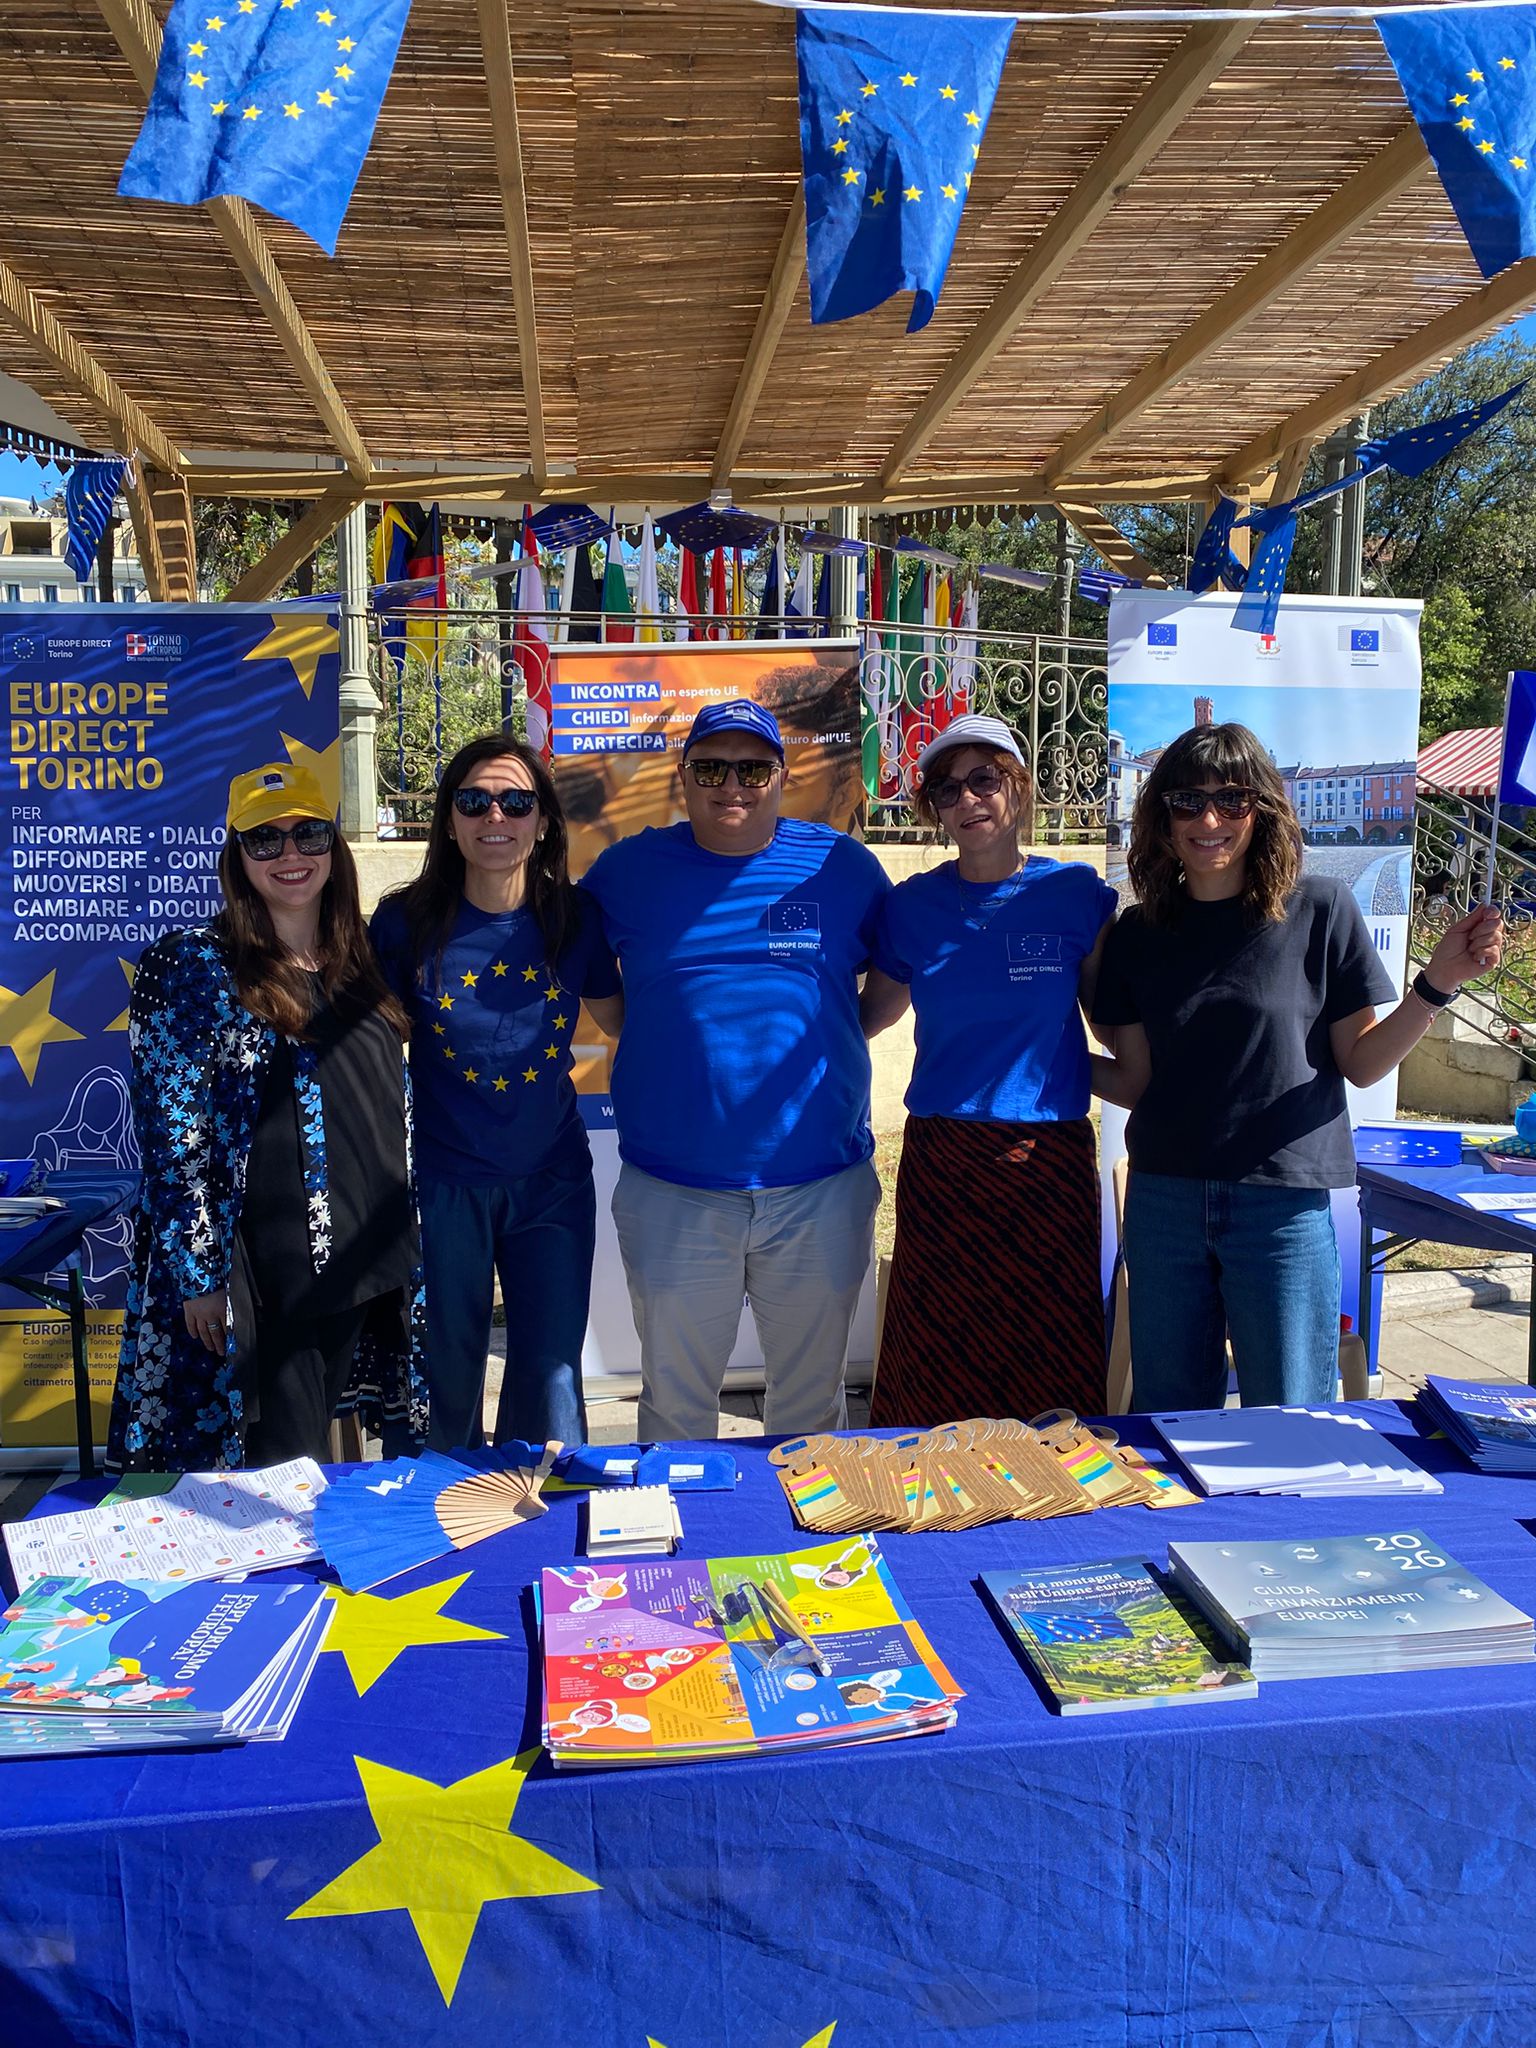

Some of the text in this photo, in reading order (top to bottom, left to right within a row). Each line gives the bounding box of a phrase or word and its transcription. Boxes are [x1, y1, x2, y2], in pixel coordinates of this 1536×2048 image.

[48, 639, 112, 648] EUROPE DIRECT
[148, 635, 181, 646] TORINO
[48, 650, 73, 658] Torino
[9, 682, 169, 715] EUROPE
[571, 684, 739, 699] INCONTRA un esperto UE
[571, 710, 629, 725] CHIEDI
[10, 720, 154, 752] DIRECT
[573, 735, 664, 750] PARTECIPA
[10, 757, 164, 789] TORINO
[12, 806, 41, 820] PER
[12, 825, 227, 845] INFORMARE DIALO
[12, 851, 147, 869] DIFFONDERE
[13, 875, 222, 894] MUOVERSI DIBATT
[14, 900, 227, 918] CAMBIARE DOCUM
[24, 1324, 71, 1335] EUROP
[1365, 1534, 1422, 1551] 20
[1391, 1550, 1446, 1571] 26
[1026, 1573, 1122, 1589] La montagna
[1096, 1578, 1154, 1592] europea
[1253, 1585, 1320, 1595] GUIDA
[1264, 1592, 1425, 1608] FINANZIAMENTI
[1276, 1610, 1369, 1621] EUROPEI
[174, 1593, 260, 1680] ESPLORIAMO
